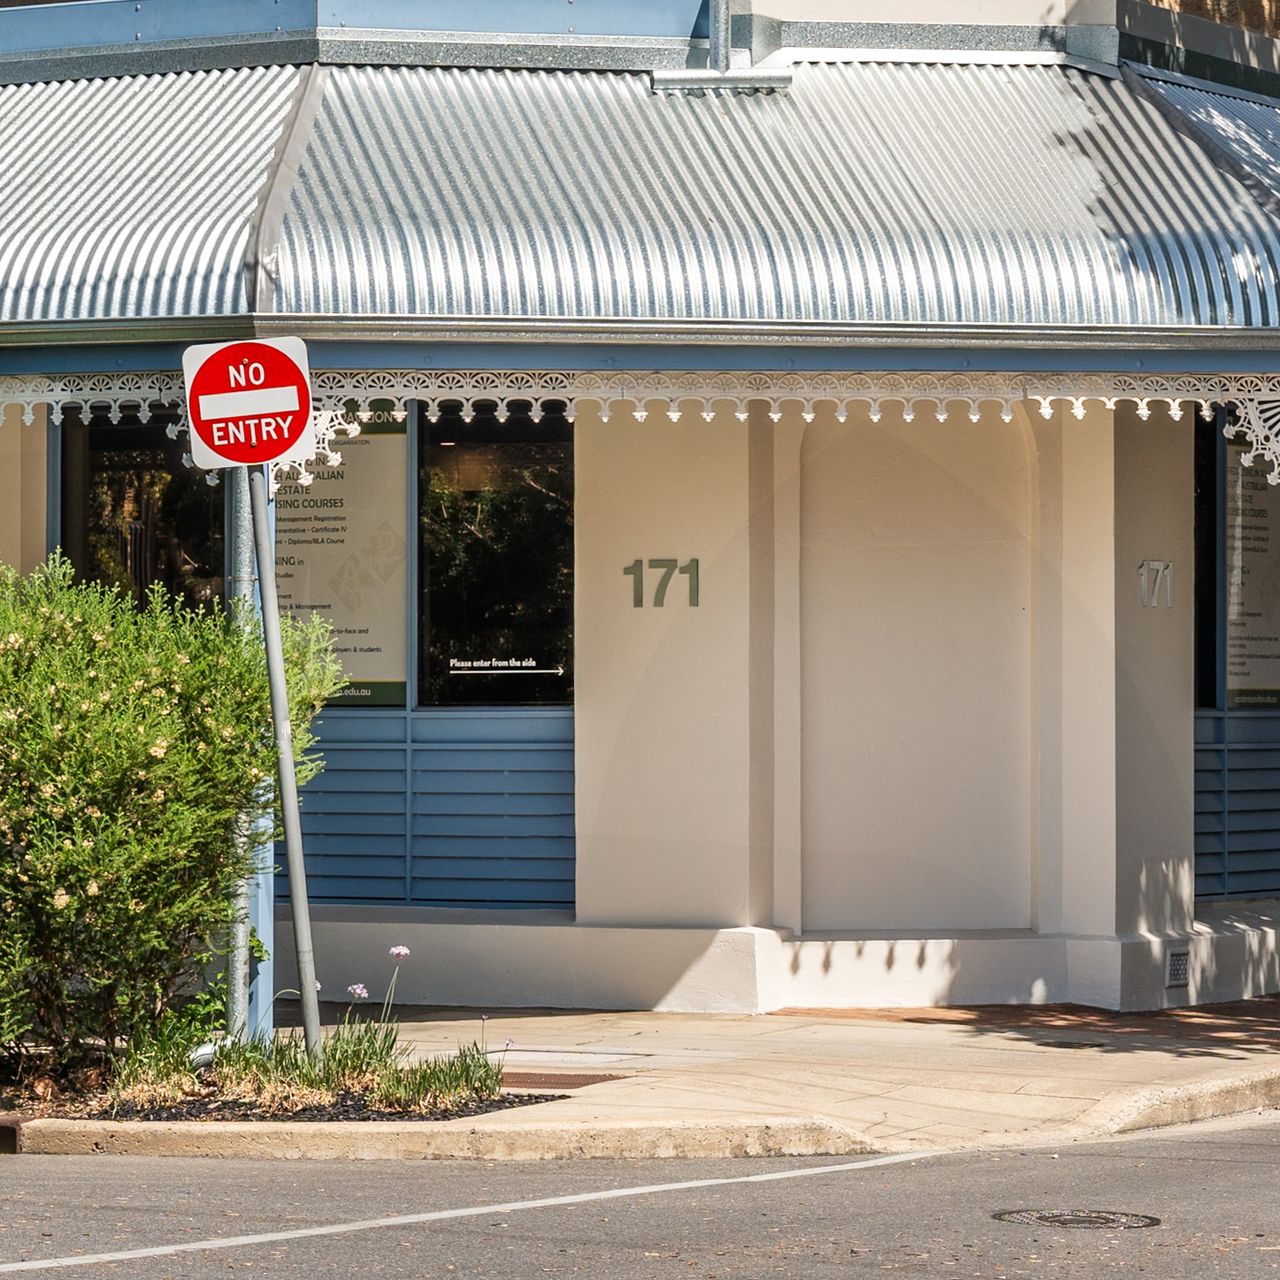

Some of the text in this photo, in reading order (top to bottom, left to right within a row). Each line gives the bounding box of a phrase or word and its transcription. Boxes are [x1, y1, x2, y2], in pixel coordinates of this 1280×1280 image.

[228, 362, 265, 388] NO
[212, 415, 293, 446] ENTRY
[302, 498, 344, 508] COURSES
[623, 558, 699, 608] 171
[1136, 560, 1174, 608] 171
[450, 659, 472, 667] Please
[492, 658, 509, 667] from
[509, 658, 521, 667] the
[522, 658, 536, 667] side
